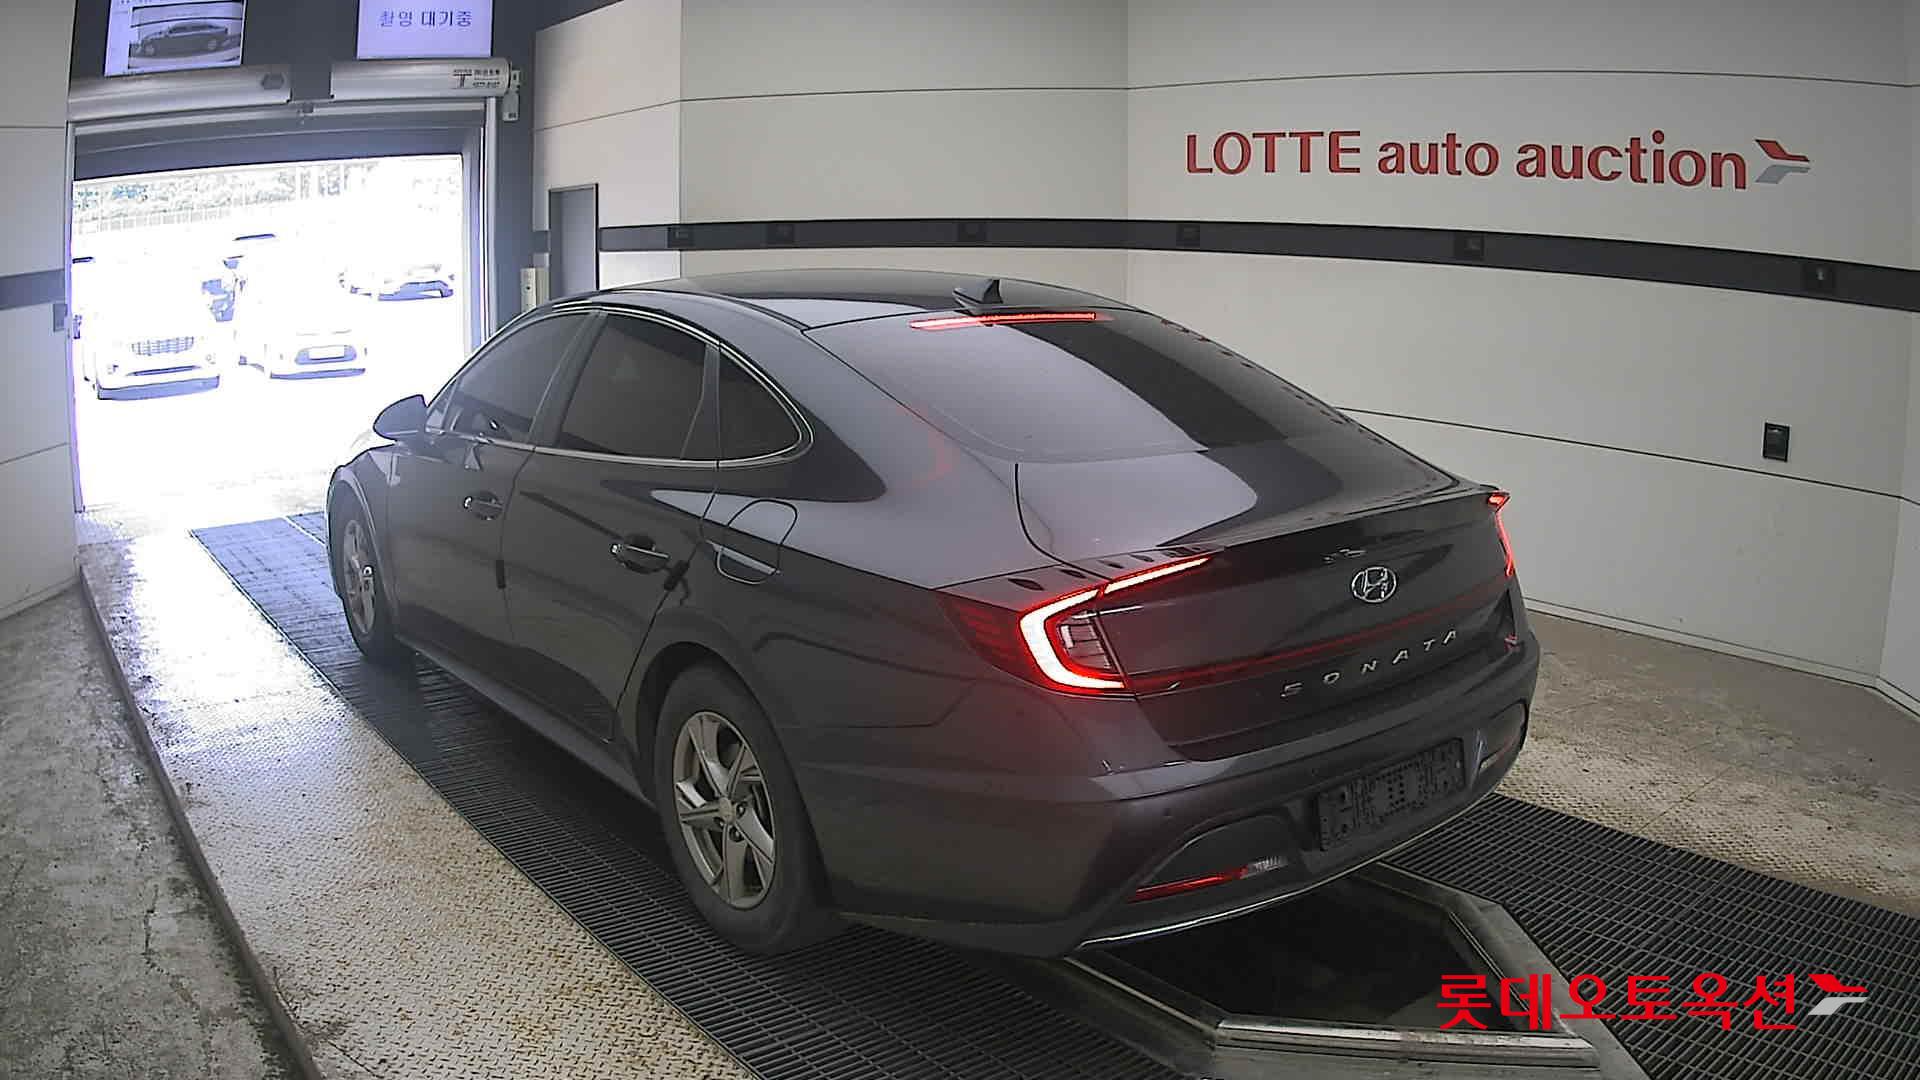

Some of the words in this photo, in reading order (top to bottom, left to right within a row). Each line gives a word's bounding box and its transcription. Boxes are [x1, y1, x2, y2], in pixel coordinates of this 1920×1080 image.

[421, 10, 473, 28] 대기중
[1187, 131, 1361, 174] LOTTE
[1378, 132, 1499, 177] auto
[1516, 130, 1747, 189] auction
[1280, 629, 1458, 698] SONATA
